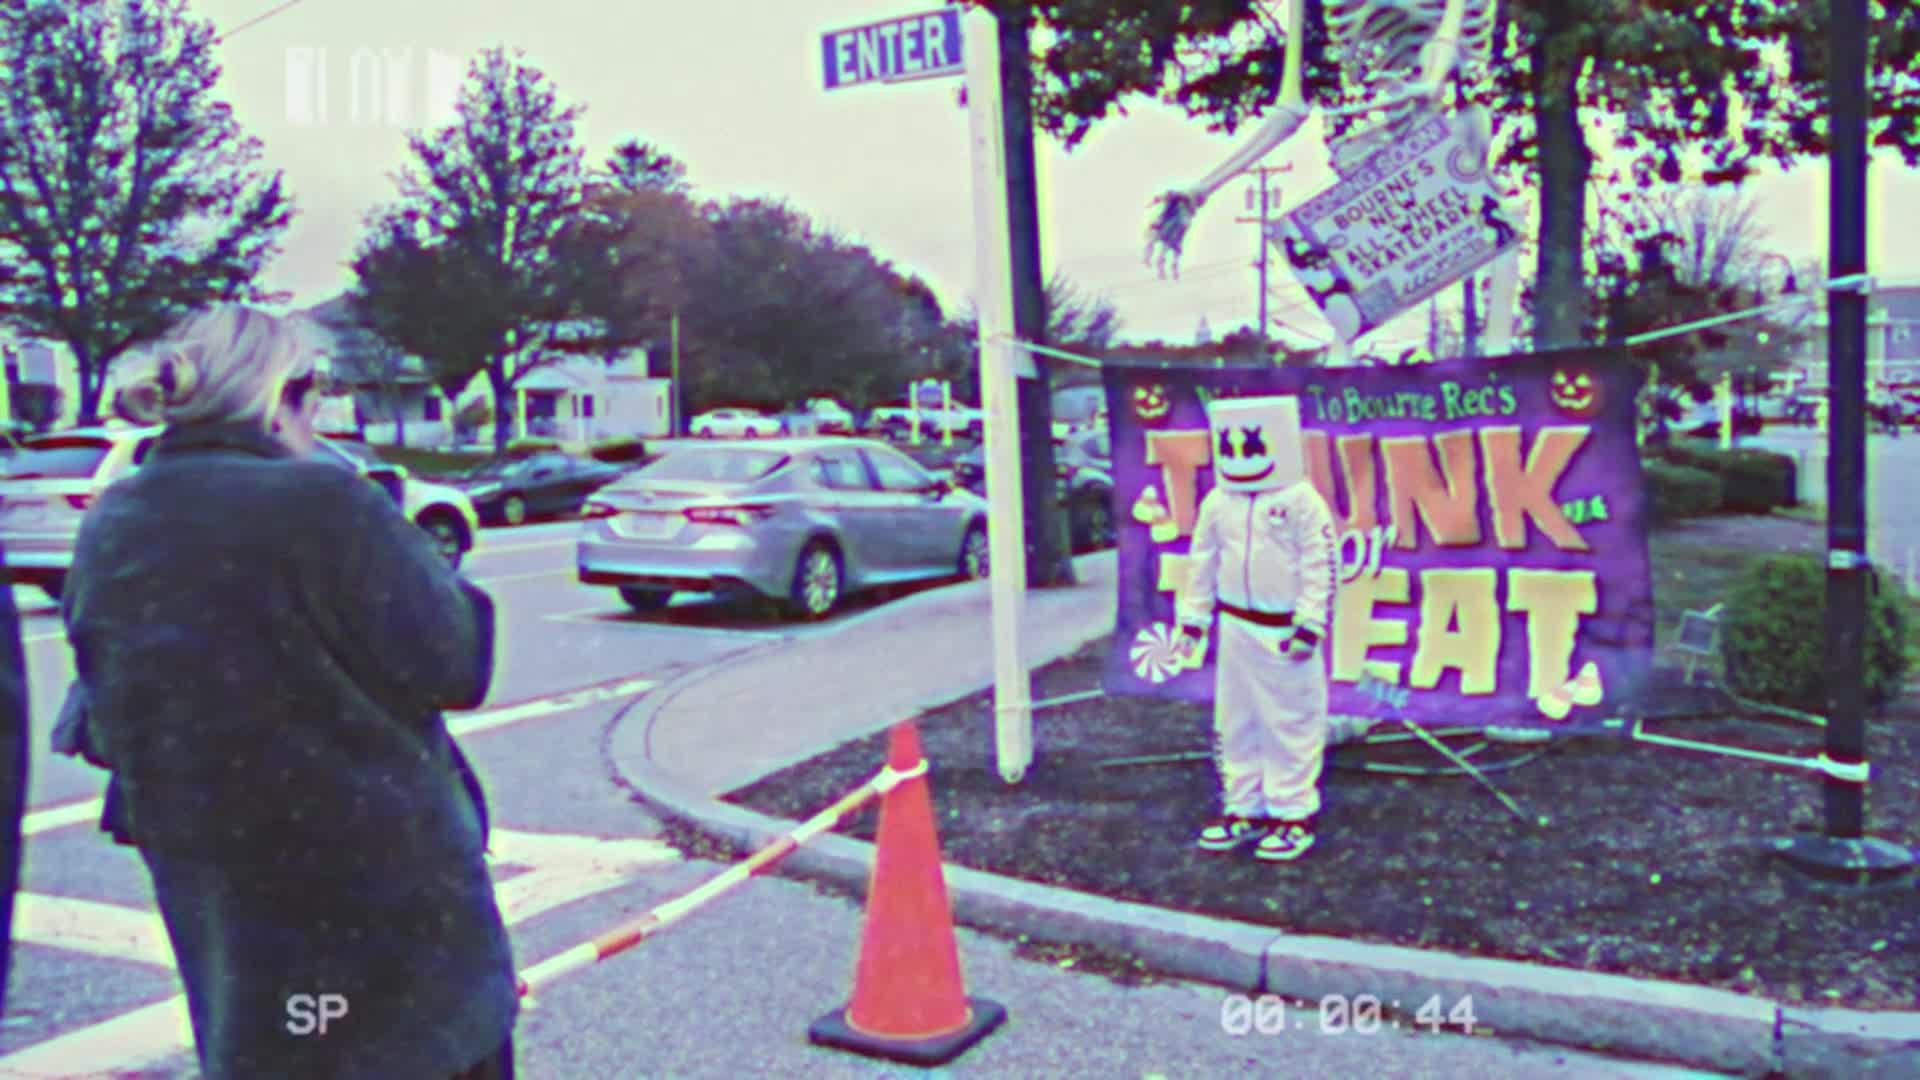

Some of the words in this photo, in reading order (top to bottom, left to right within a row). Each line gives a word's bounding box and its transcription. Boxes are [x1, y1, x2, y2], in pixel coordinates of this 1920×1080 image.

[836, 16, 948, 83] ENTER
[1333, 159, 1435, 229] BOURNES
[1345, 185, 1468, 265] ALL-WHEEL
[1368, 191, 1417, 229] NEW
[1357, 201, 1473, 277] SKATEPARK
[1307, 385, 1341, 421] To
[1343, 386, 1438, 424] Bourne
[1439, 371, 1518, 420] Rec's
[1146, 425, 1591, 552] TUNK
[1337, 525, 1397, 583] or
